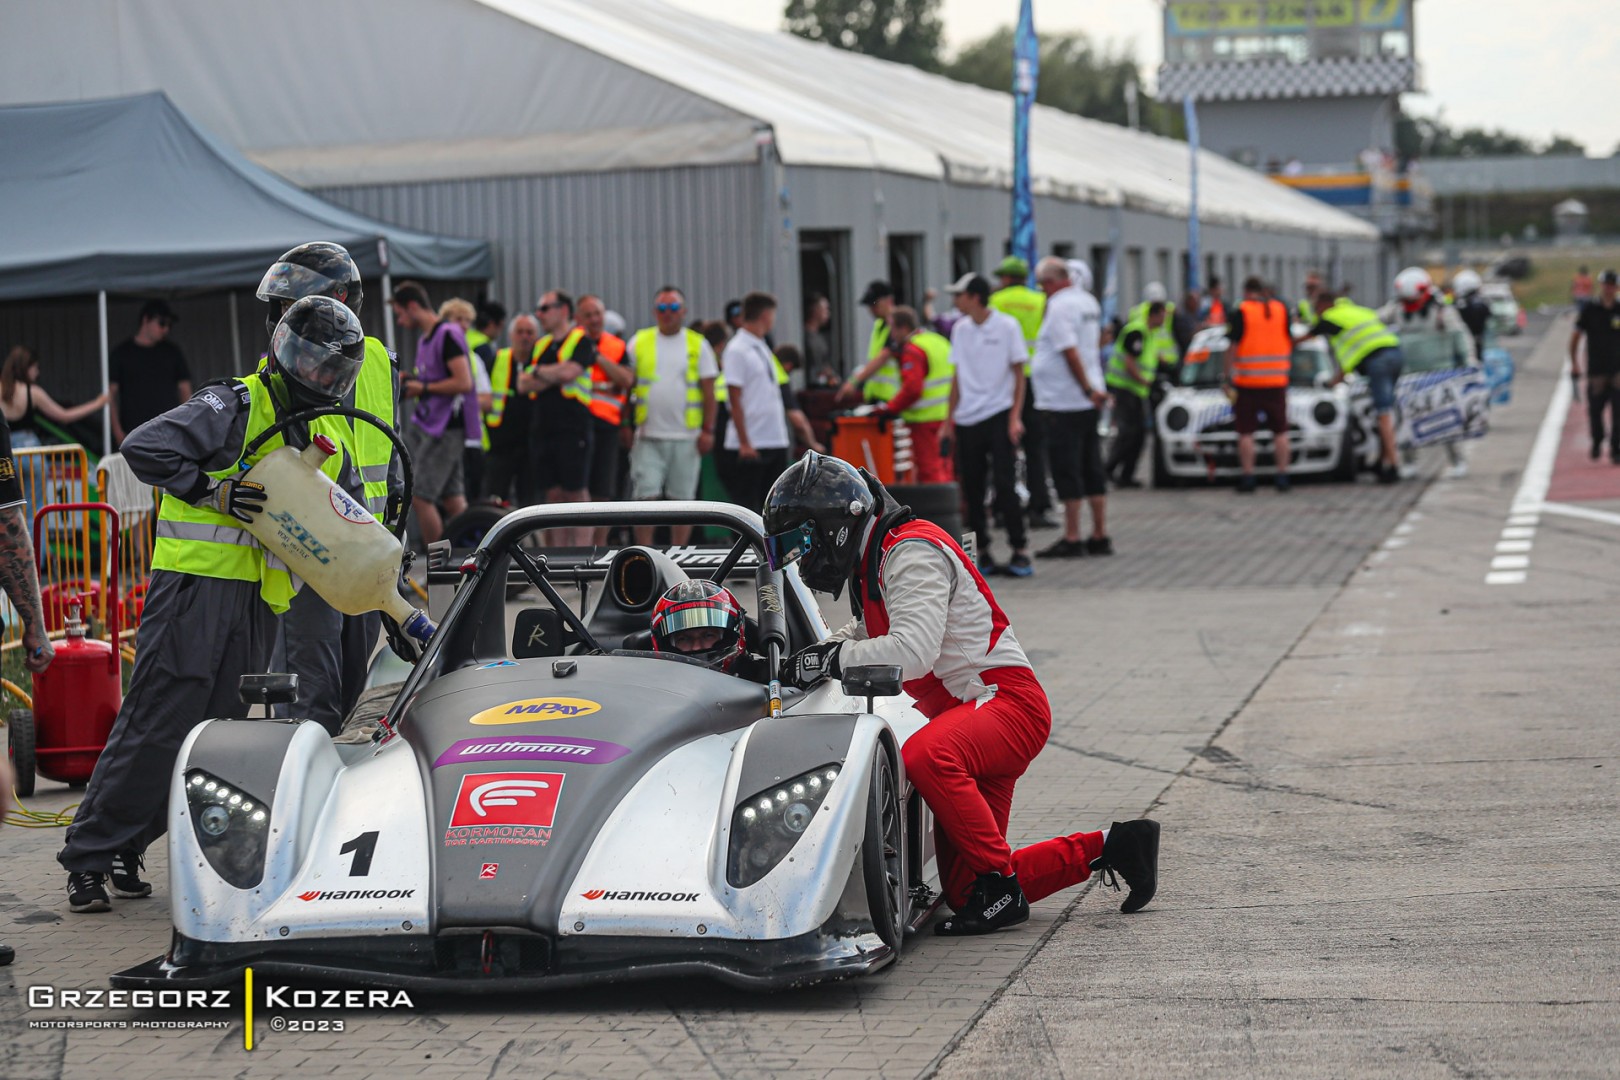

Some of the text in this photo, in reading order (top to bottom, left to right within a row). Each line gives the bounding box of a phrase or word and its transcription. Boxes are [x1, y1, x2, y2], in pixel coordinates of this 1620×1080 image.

[204, 394, 224, 410] OMP
[445, 827, 552, 839] KORMORAN
[445, 838, 550, 847] TOR KARTINGOWY
[339, 830, 380, 877] 1
[983, 893, 1013, 919] sparco
